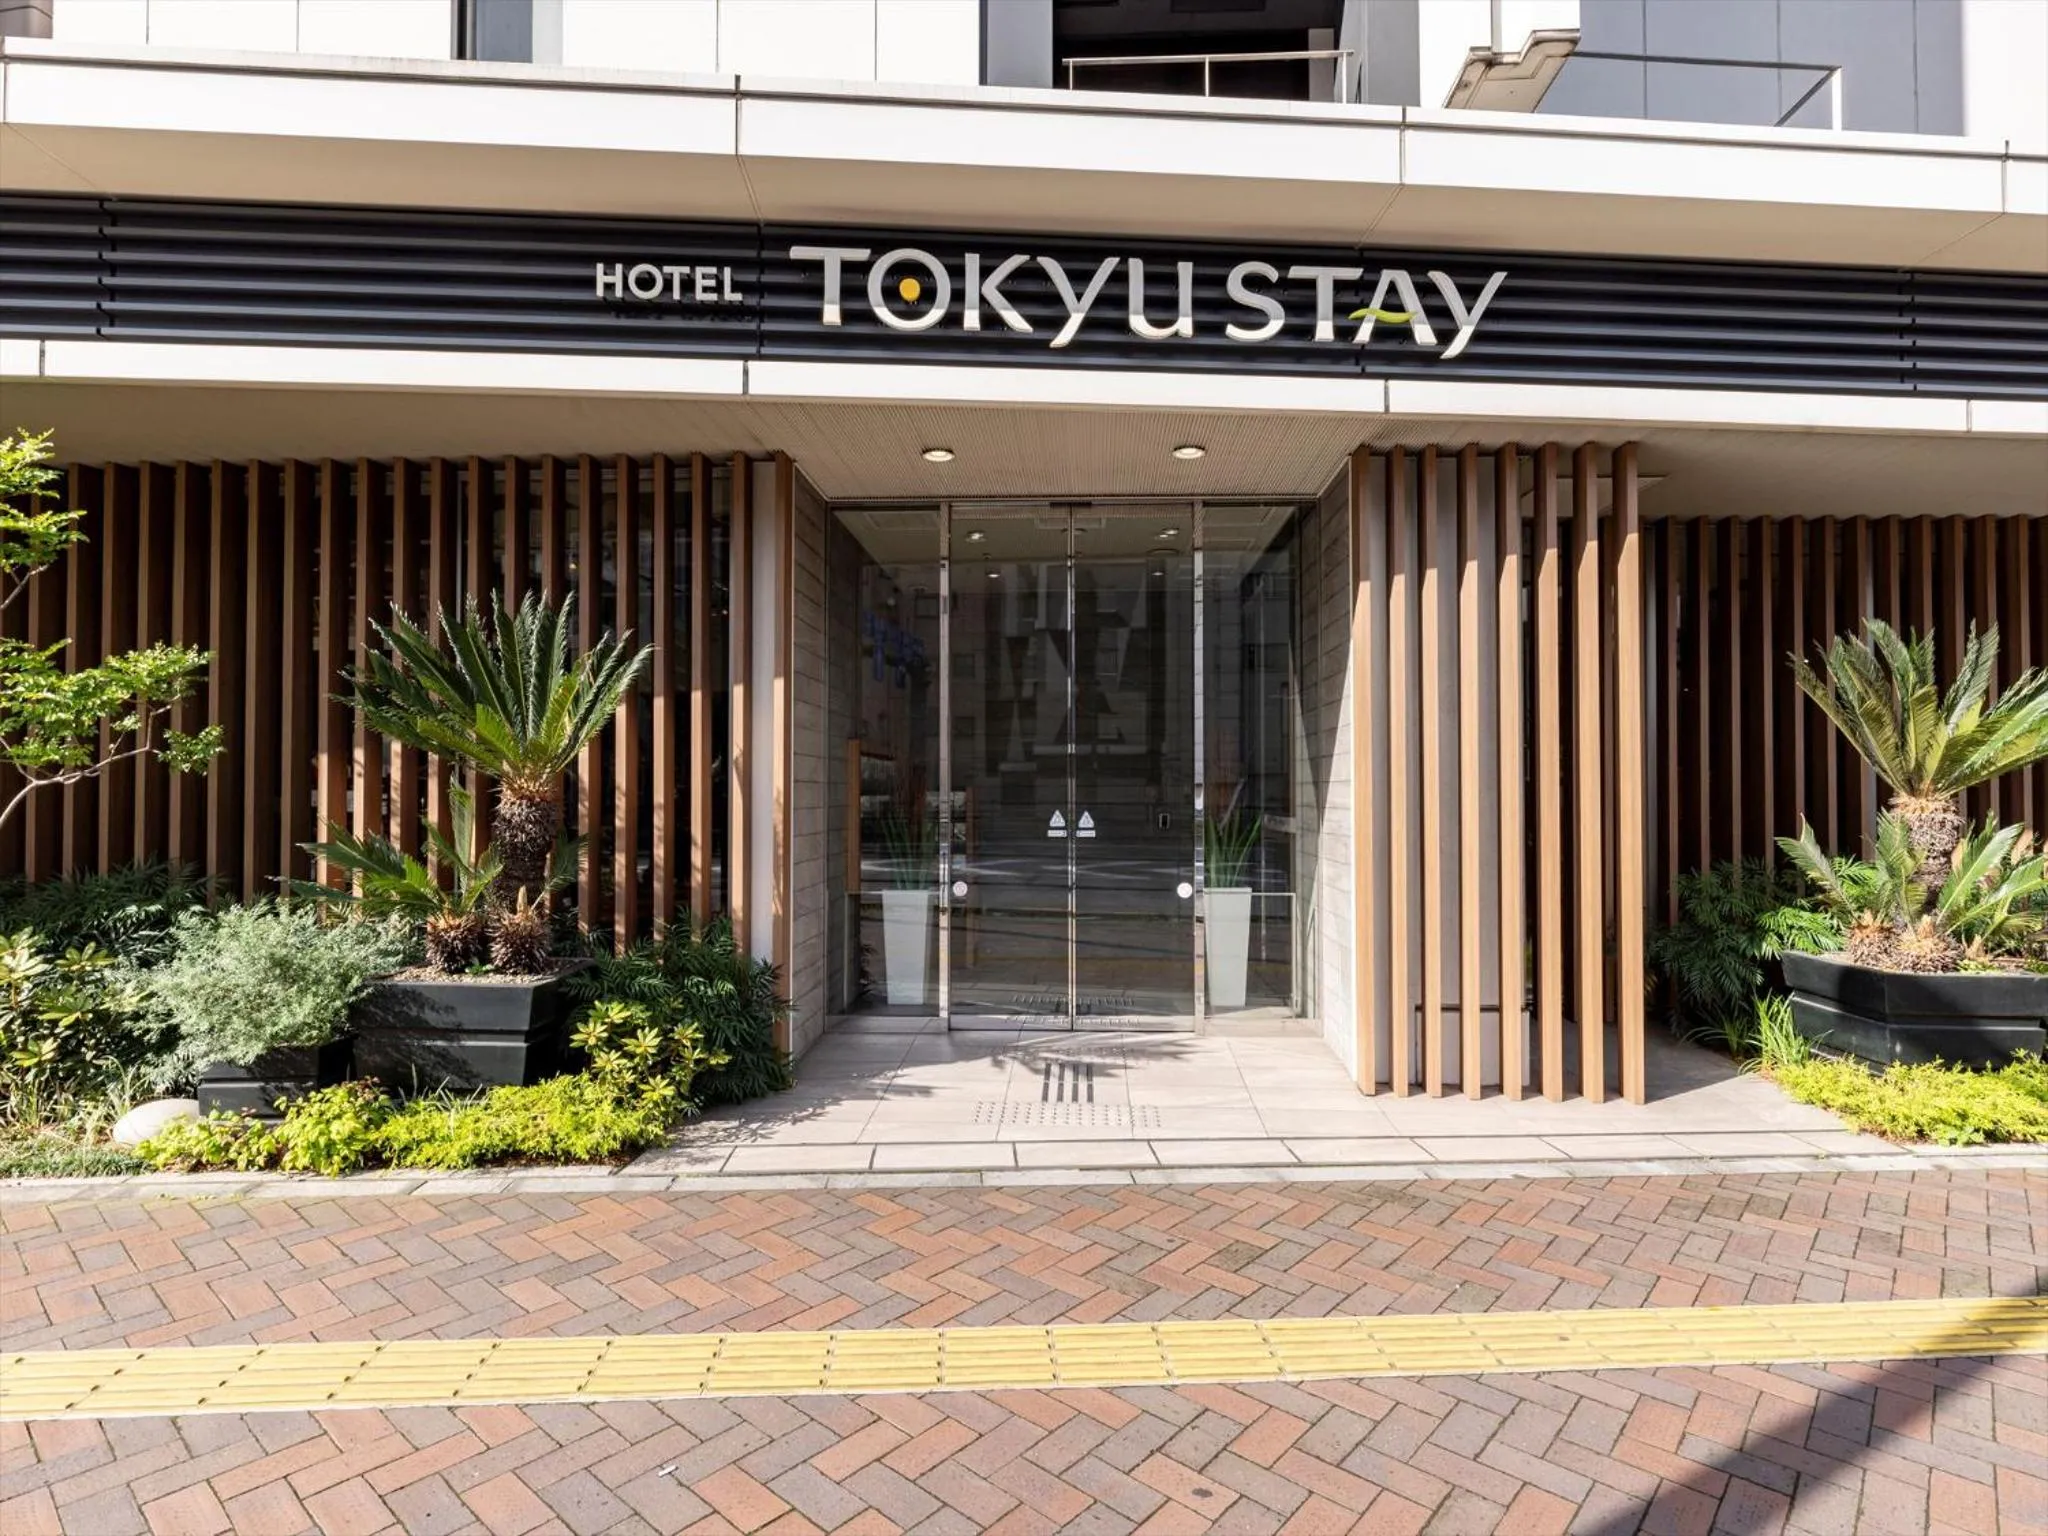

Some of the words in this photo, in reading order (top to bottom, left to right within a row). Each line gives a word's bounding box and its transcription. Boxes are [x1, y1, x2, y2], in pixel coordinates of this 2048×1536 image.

[595, 262, 743, 301] HOTEL
[789, 245, 1194, 348] TOKYU
[1225, 261, 1508, 360] STAY
